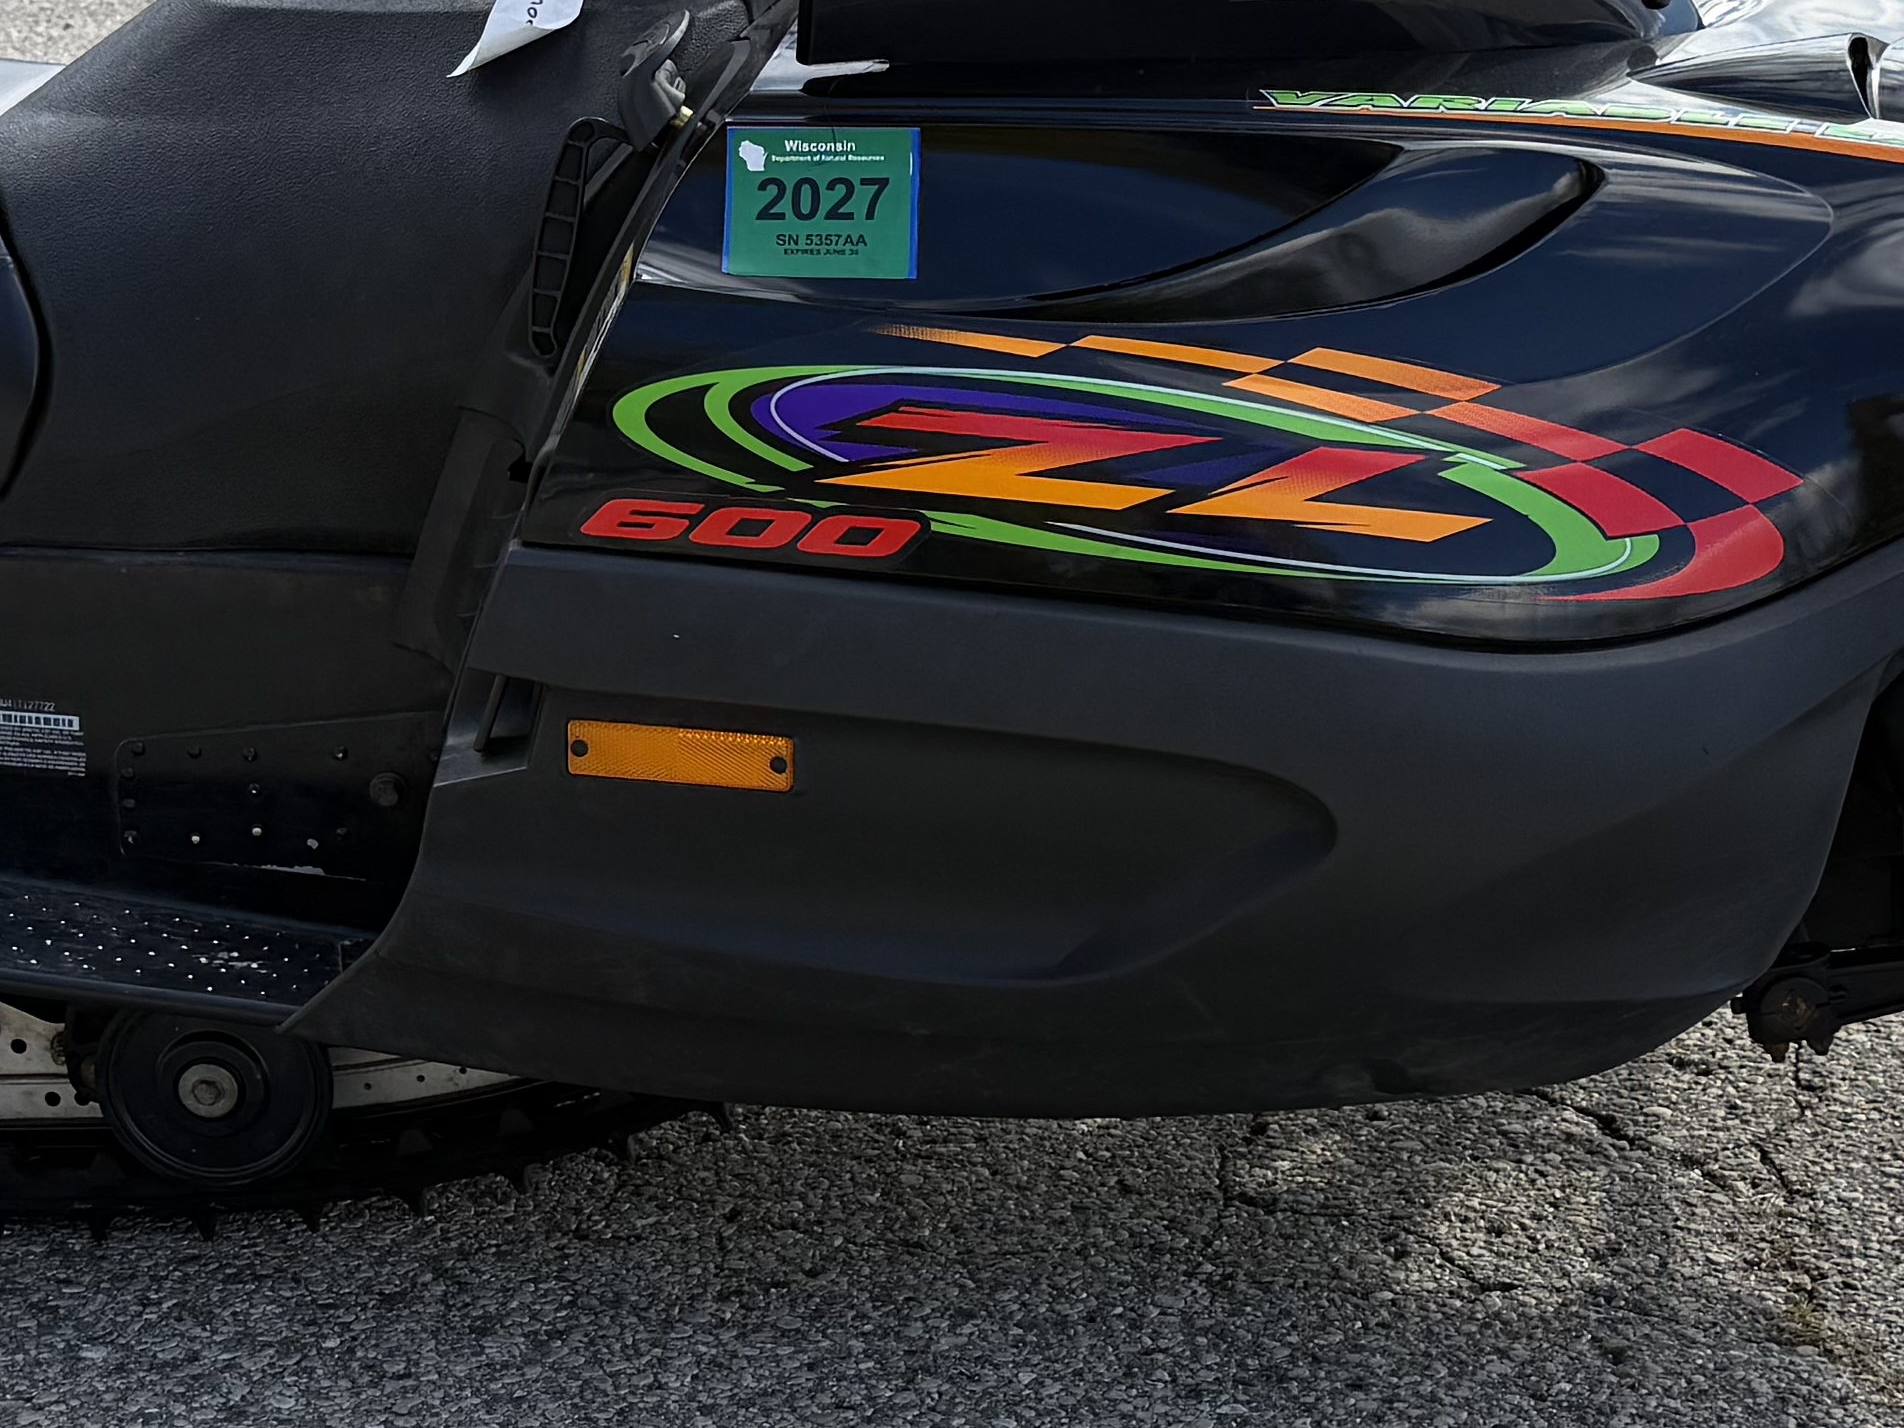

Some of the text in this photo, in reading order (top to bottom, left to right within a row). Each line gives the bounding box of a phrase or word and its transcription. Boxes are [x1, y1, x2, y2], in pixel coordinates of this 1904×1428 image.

[1260, 89, 1798, 134] VARIABLE
[784, 139, 856, 152] Wisconsin
[771, 154, 812, 163] Department
[848, 154, 885, 162] Resources
[755, 176, 891, 222] 2027
[776, 233, 868, 247] SN 5357AA
[783, 248, 821, 256] EXPIRES
[823, 248, 847, 256] JUNE
[577, 496, 925, 560] 600
